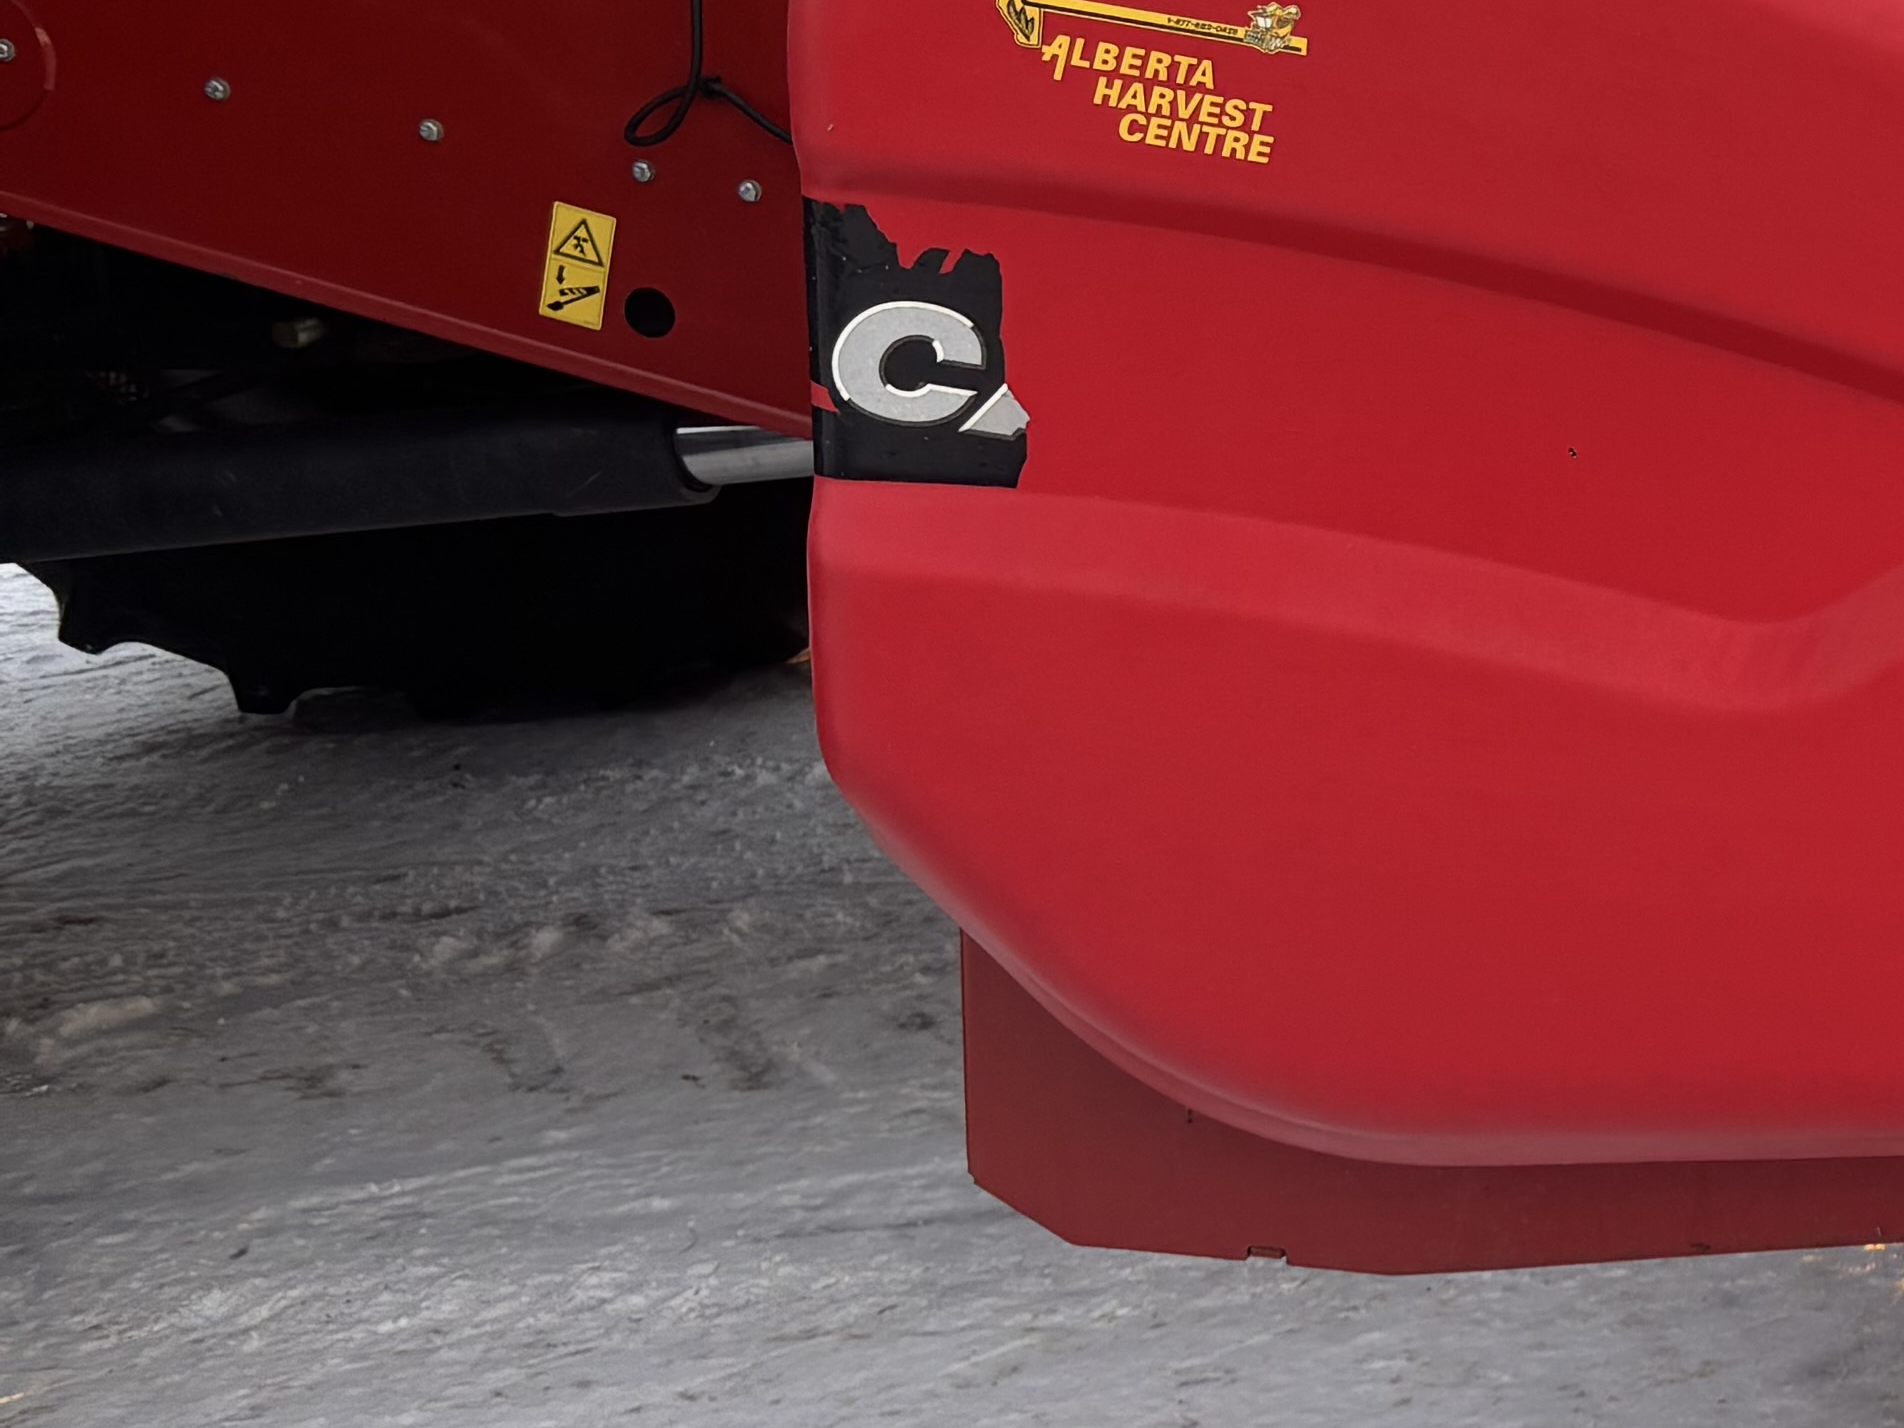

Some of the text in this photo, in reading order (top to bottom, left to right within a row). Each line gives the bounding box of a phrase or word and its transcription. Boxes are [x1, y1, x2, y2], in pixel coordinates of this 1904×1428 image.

[1041, 34, 1215, 90] ALBERTA
[1093, 76, 1273, 132] HARVEST
[1118, 112, 1275, 164] CENTRE
[831, 300, 1030, 434] C
